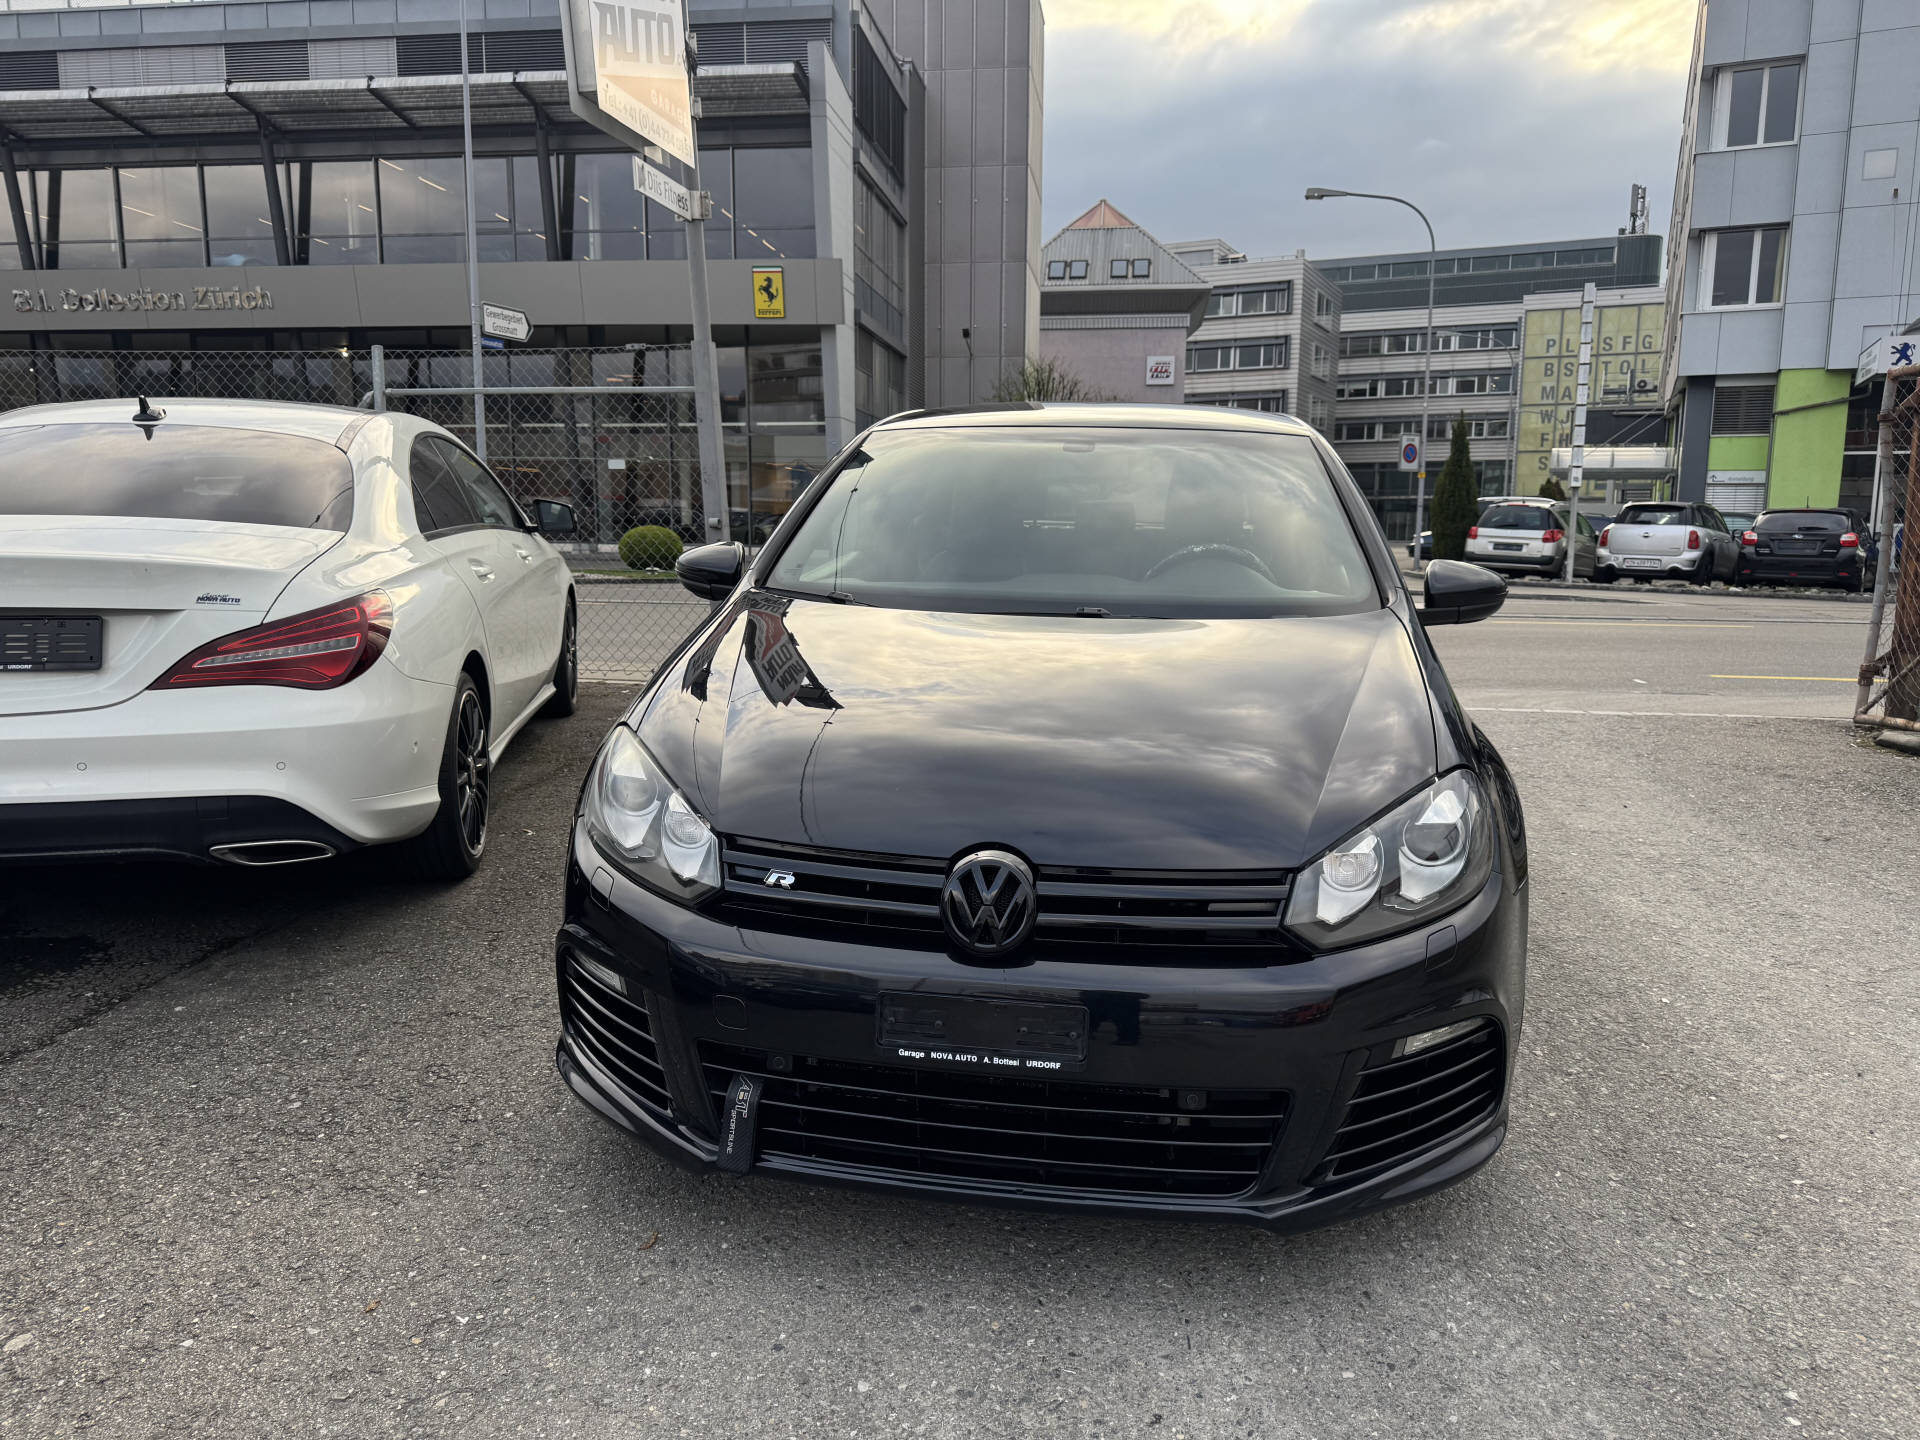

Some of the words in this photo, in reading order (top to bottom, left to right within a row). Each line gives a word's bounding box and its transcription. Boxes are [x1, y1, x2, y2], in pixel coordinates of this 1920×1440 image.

[593, 1, 675, 68] AUTO
[663, 180, 690, 213] Fitness
[60, 287, 187, 312] Collection
[191, 286, 273, 311] Zürich
[763, 868, 796, 889] R
[898, 1048, 925, 1058] Garage
[930, 1051, 953, 1060] NOVA
[954, 1053, 978, 1062] AUTO
[1026, 1060, 1061, 1069] URDORF
[726, 1109, 737, 1155] SPORTSLINE
